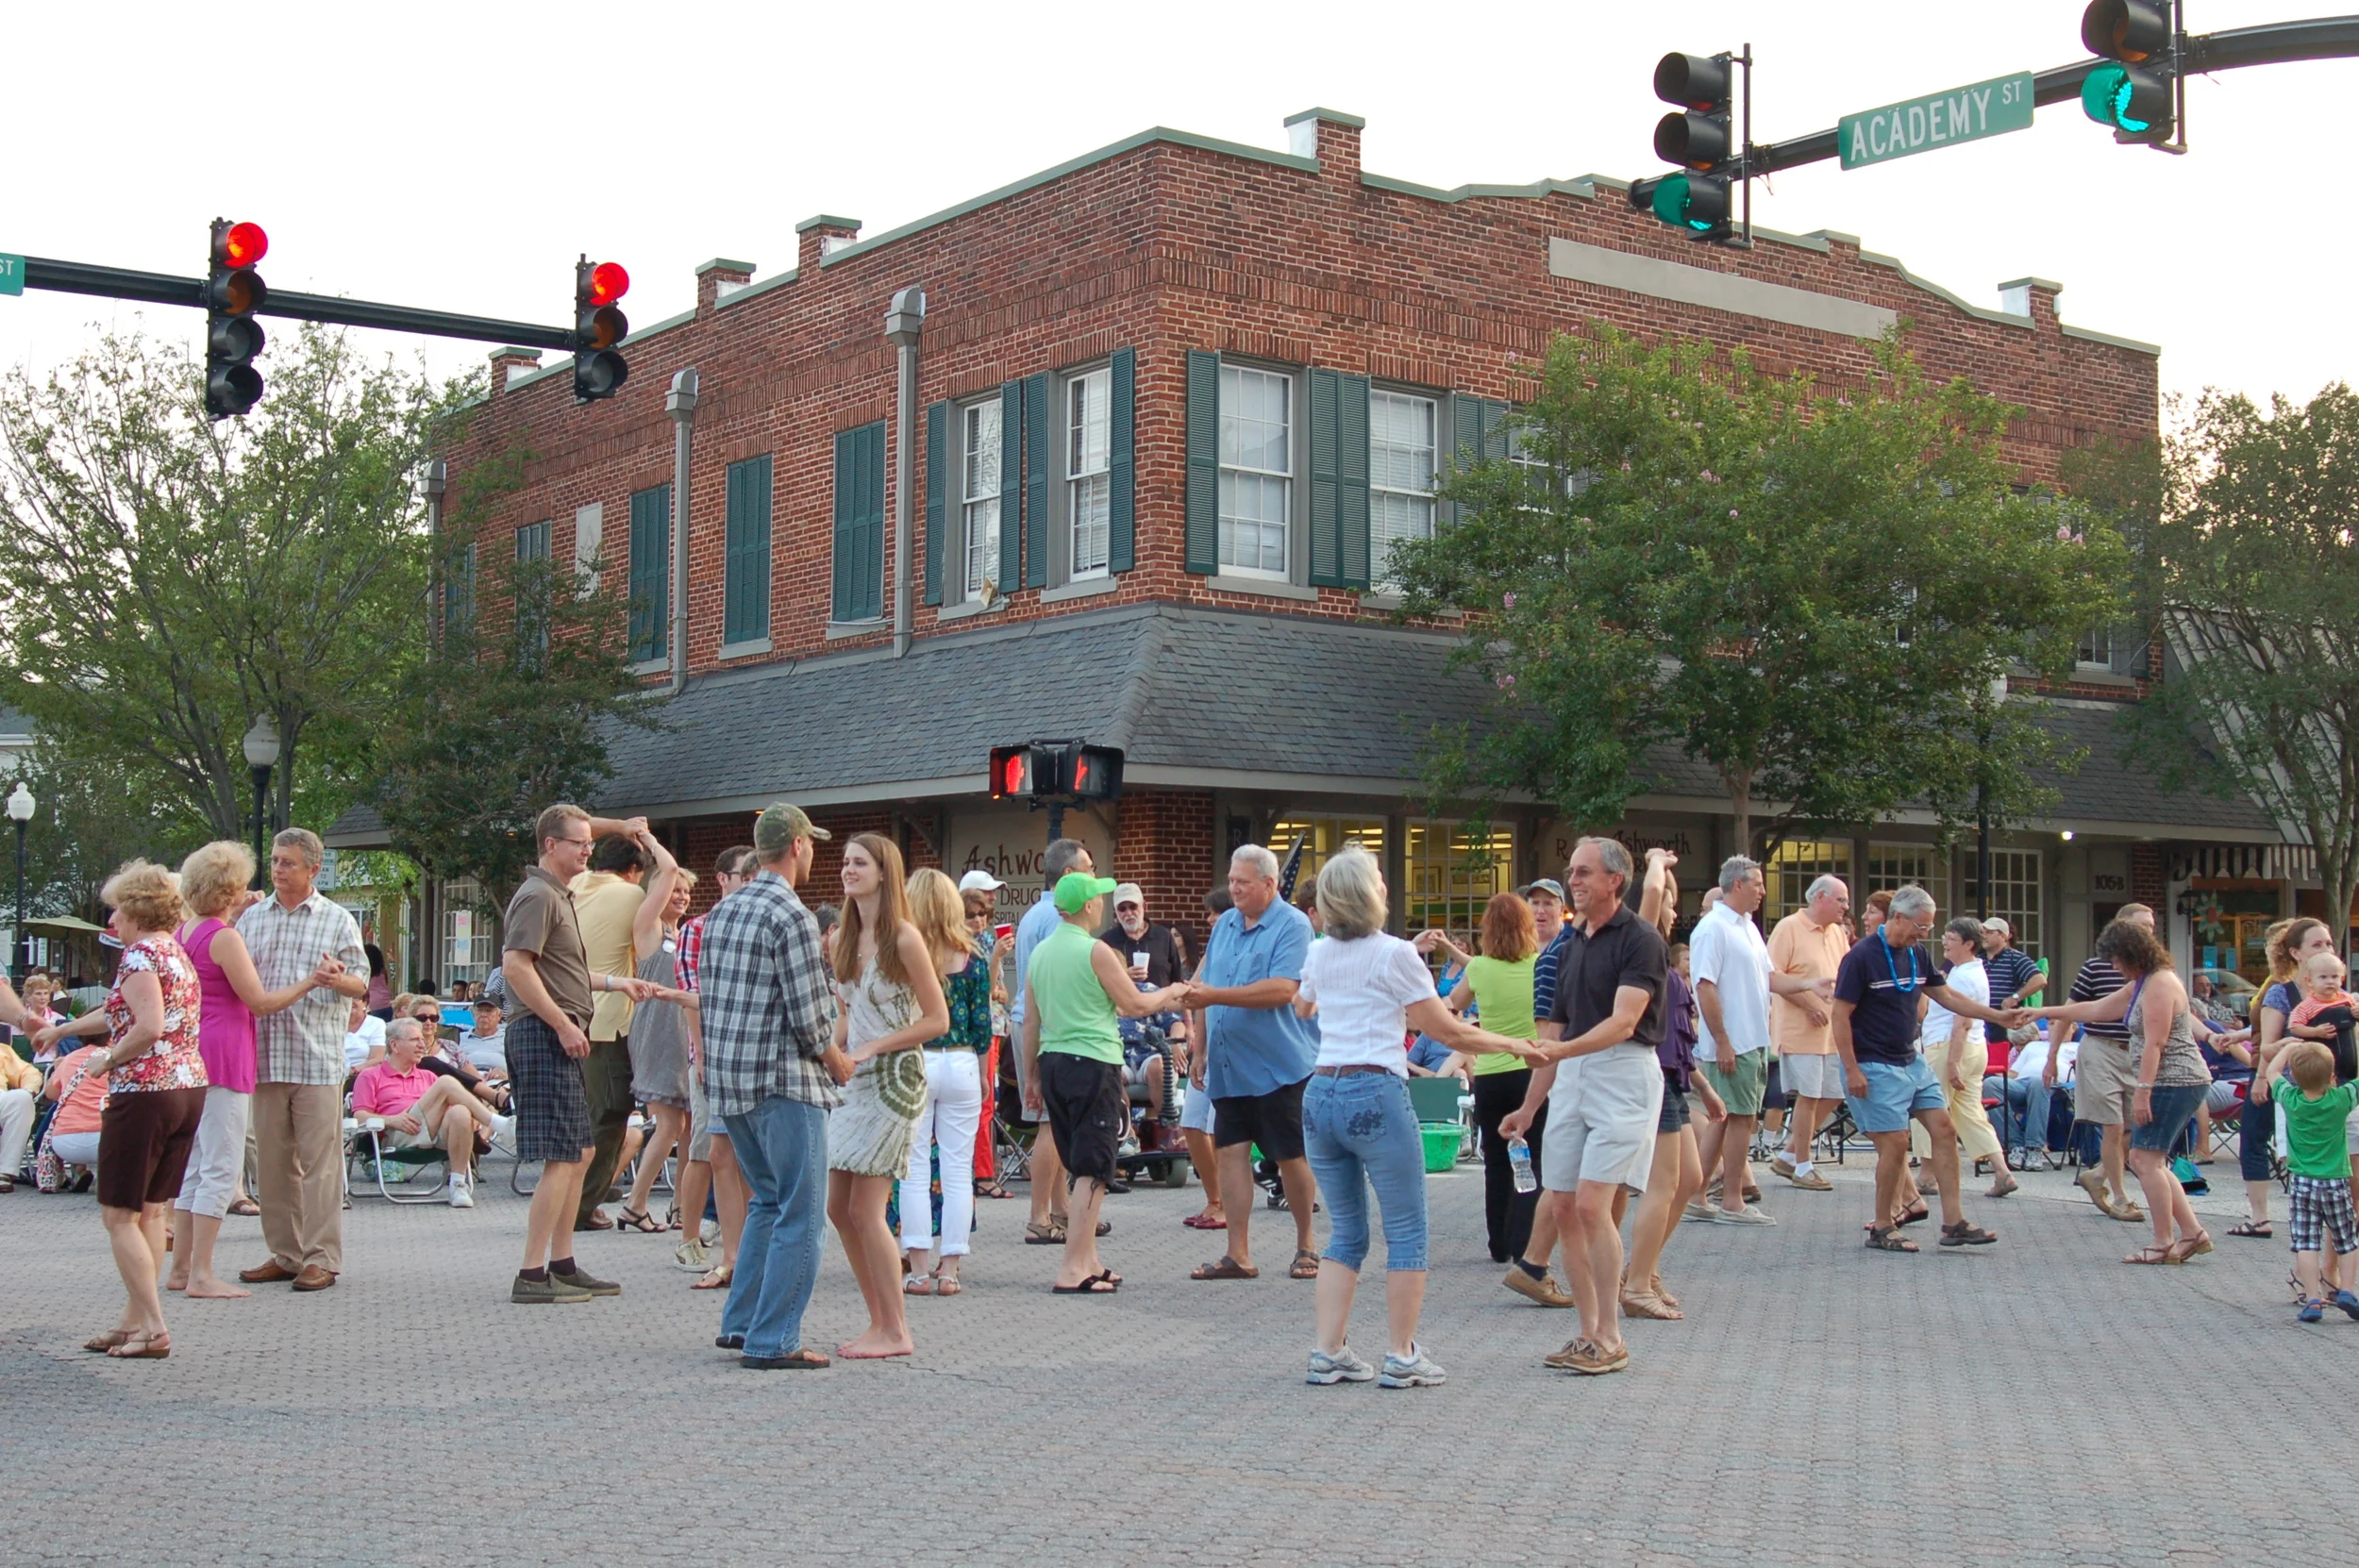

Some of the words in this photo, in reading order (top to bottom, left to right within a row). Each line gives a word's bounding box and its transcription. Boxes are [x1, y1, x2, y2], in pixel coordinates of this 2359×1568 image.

[1850, 89, 1991, 160] ACADEMY
[2002, 80, 2022, 105] ST
[1612, 829, 1691, 855] Ashworth
[962, 840, 1096, 876] Ashwo
[994, 910, 1019, 926] SPITAL
